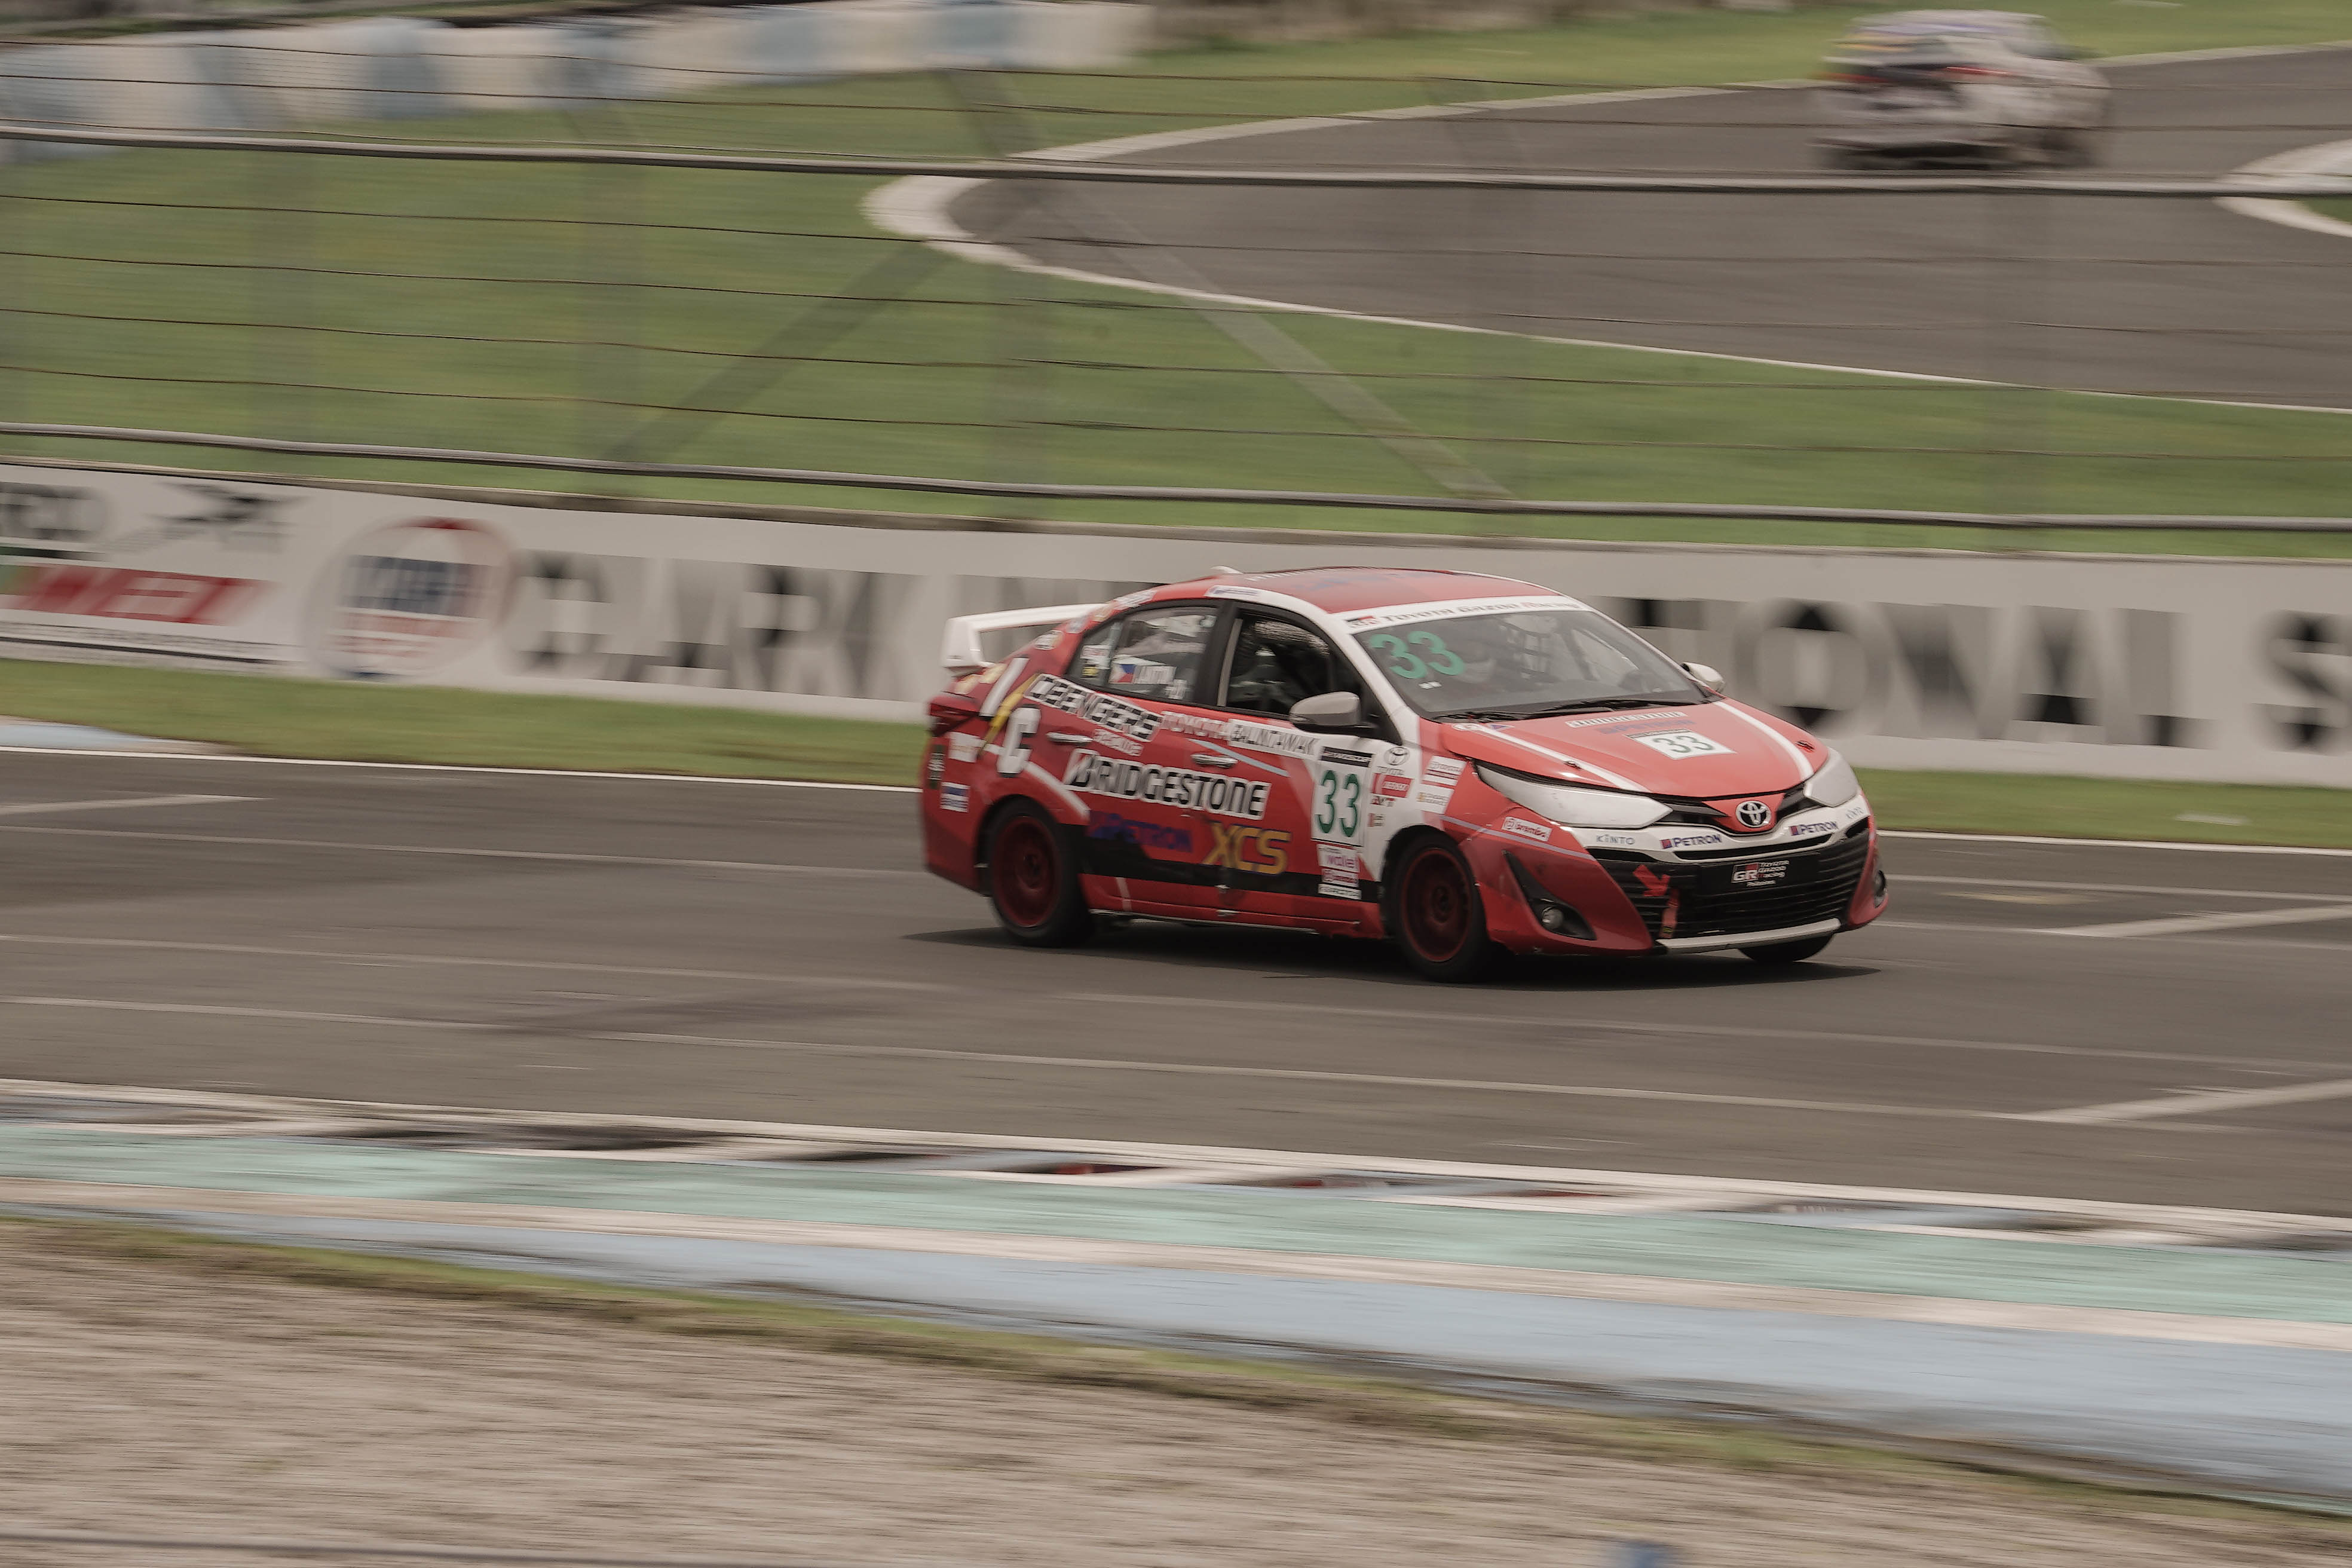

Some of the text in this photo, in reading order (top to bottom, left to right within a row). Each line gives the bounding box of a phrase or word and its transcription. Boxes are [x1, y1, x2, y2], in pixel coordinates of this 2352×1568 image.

[1370, 630, 1466, 679] 33
[1652, 736, 1716, 753] 33
[1065, 750, 1270, 819] BRIDGESTONE
[1315, 770, 1359, 837] 33
[1672, 834, 1723, 847] PETRON
[1797, 821, 1839, 834] PETRON
[1202, 820, 1293, 875] XCS
[1734, 870, 1758, 881] GR
